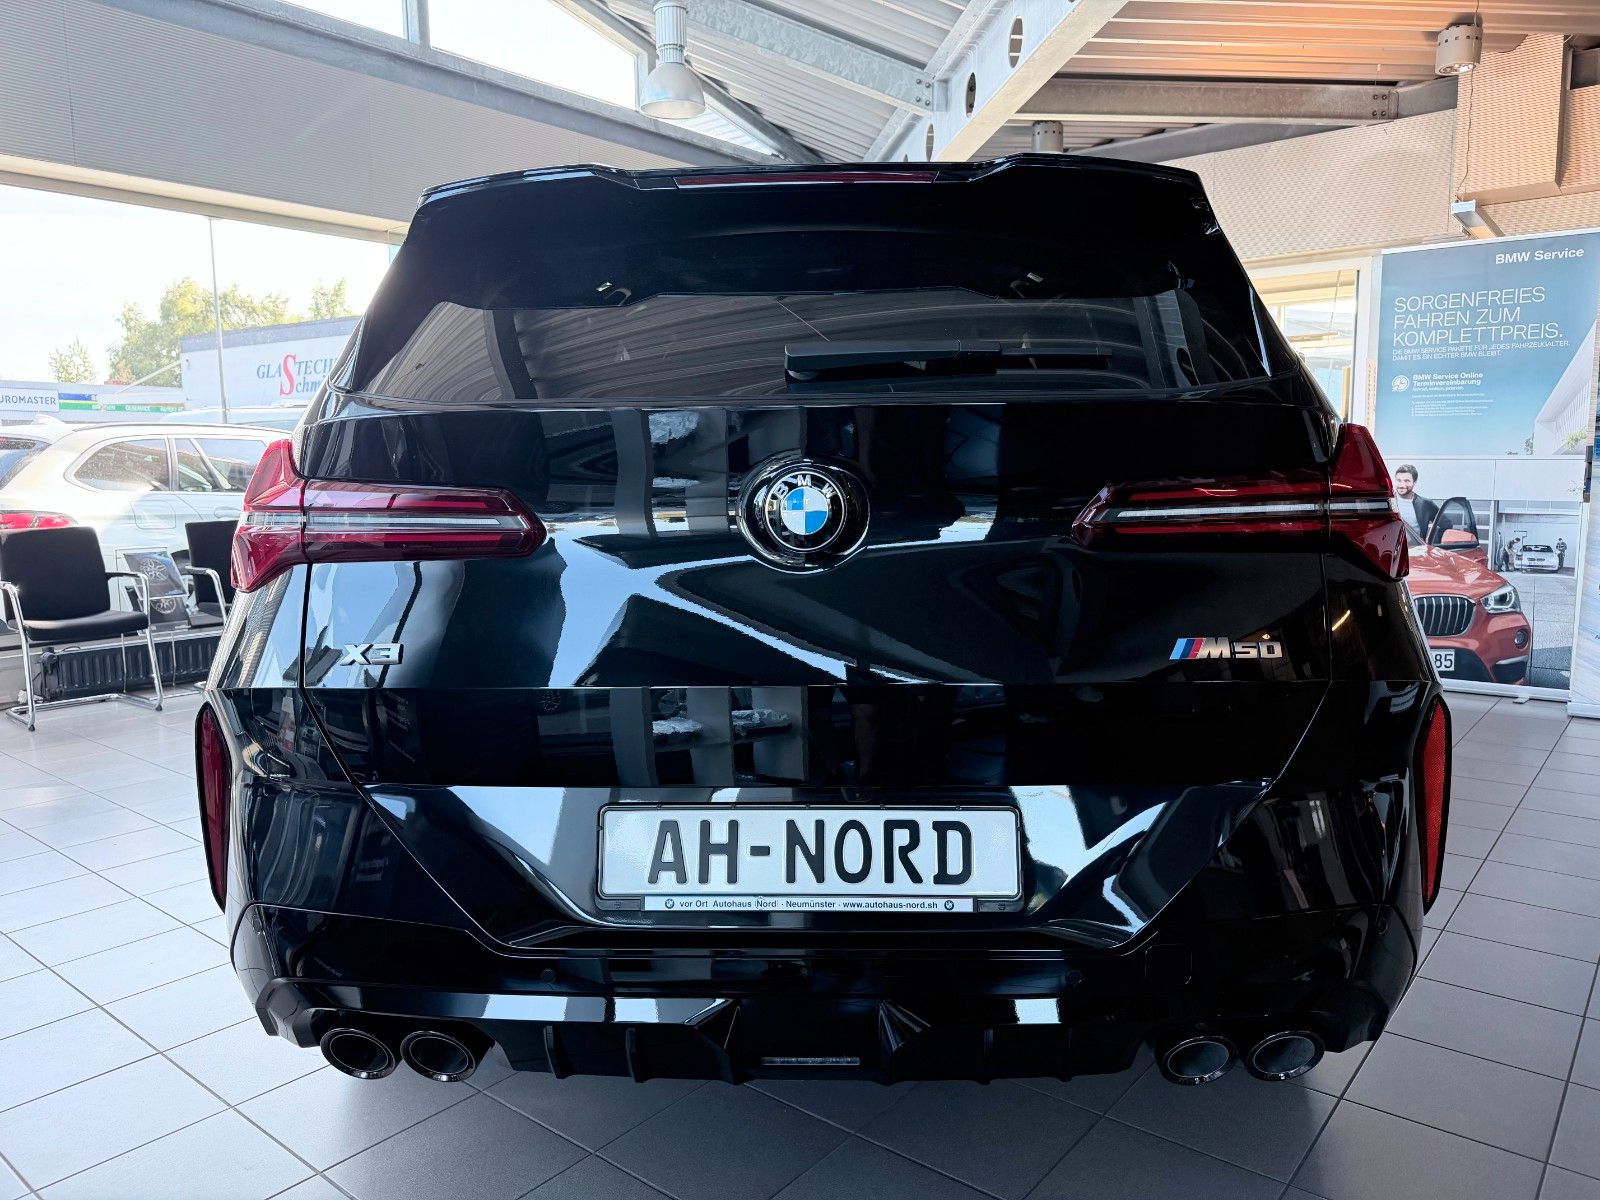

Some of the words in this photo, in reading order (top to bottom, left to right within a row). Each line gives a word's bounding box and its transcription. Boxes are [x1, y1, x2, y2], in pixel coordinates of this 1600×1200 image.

[1495, 252, 1530, 264] BMW
[1534, 247, 1585, 261] Service
[1394, 287, 1545, 313] SORGENFREIES
[1394, 310, 1470, 329] FAHREN
[1476, 306, 1520, 324] ZUM
[1393, 322, 1563, 347] KOMPLETTPREIS.
[1421, 346, 1447, 354] SERVICE
[1448, 345, 1473, 353] PAKETE
[1432, 372, 1459, 380] Service
[775, 474, 837, 499] BMW
[340, 643, 404, 666] X3
[1197, 637, 1283, 658] M50
[647, 818, 973, 885] AH-NORD
[695, 900, 708, 908] Ort
[712, 900, 752, 908] Autohaus
[756, 900, 777, 908] Nord
[785, 899, 836, 908] Neumünster
[842, 900, 938, 909] www.autohaus-nord.sh
